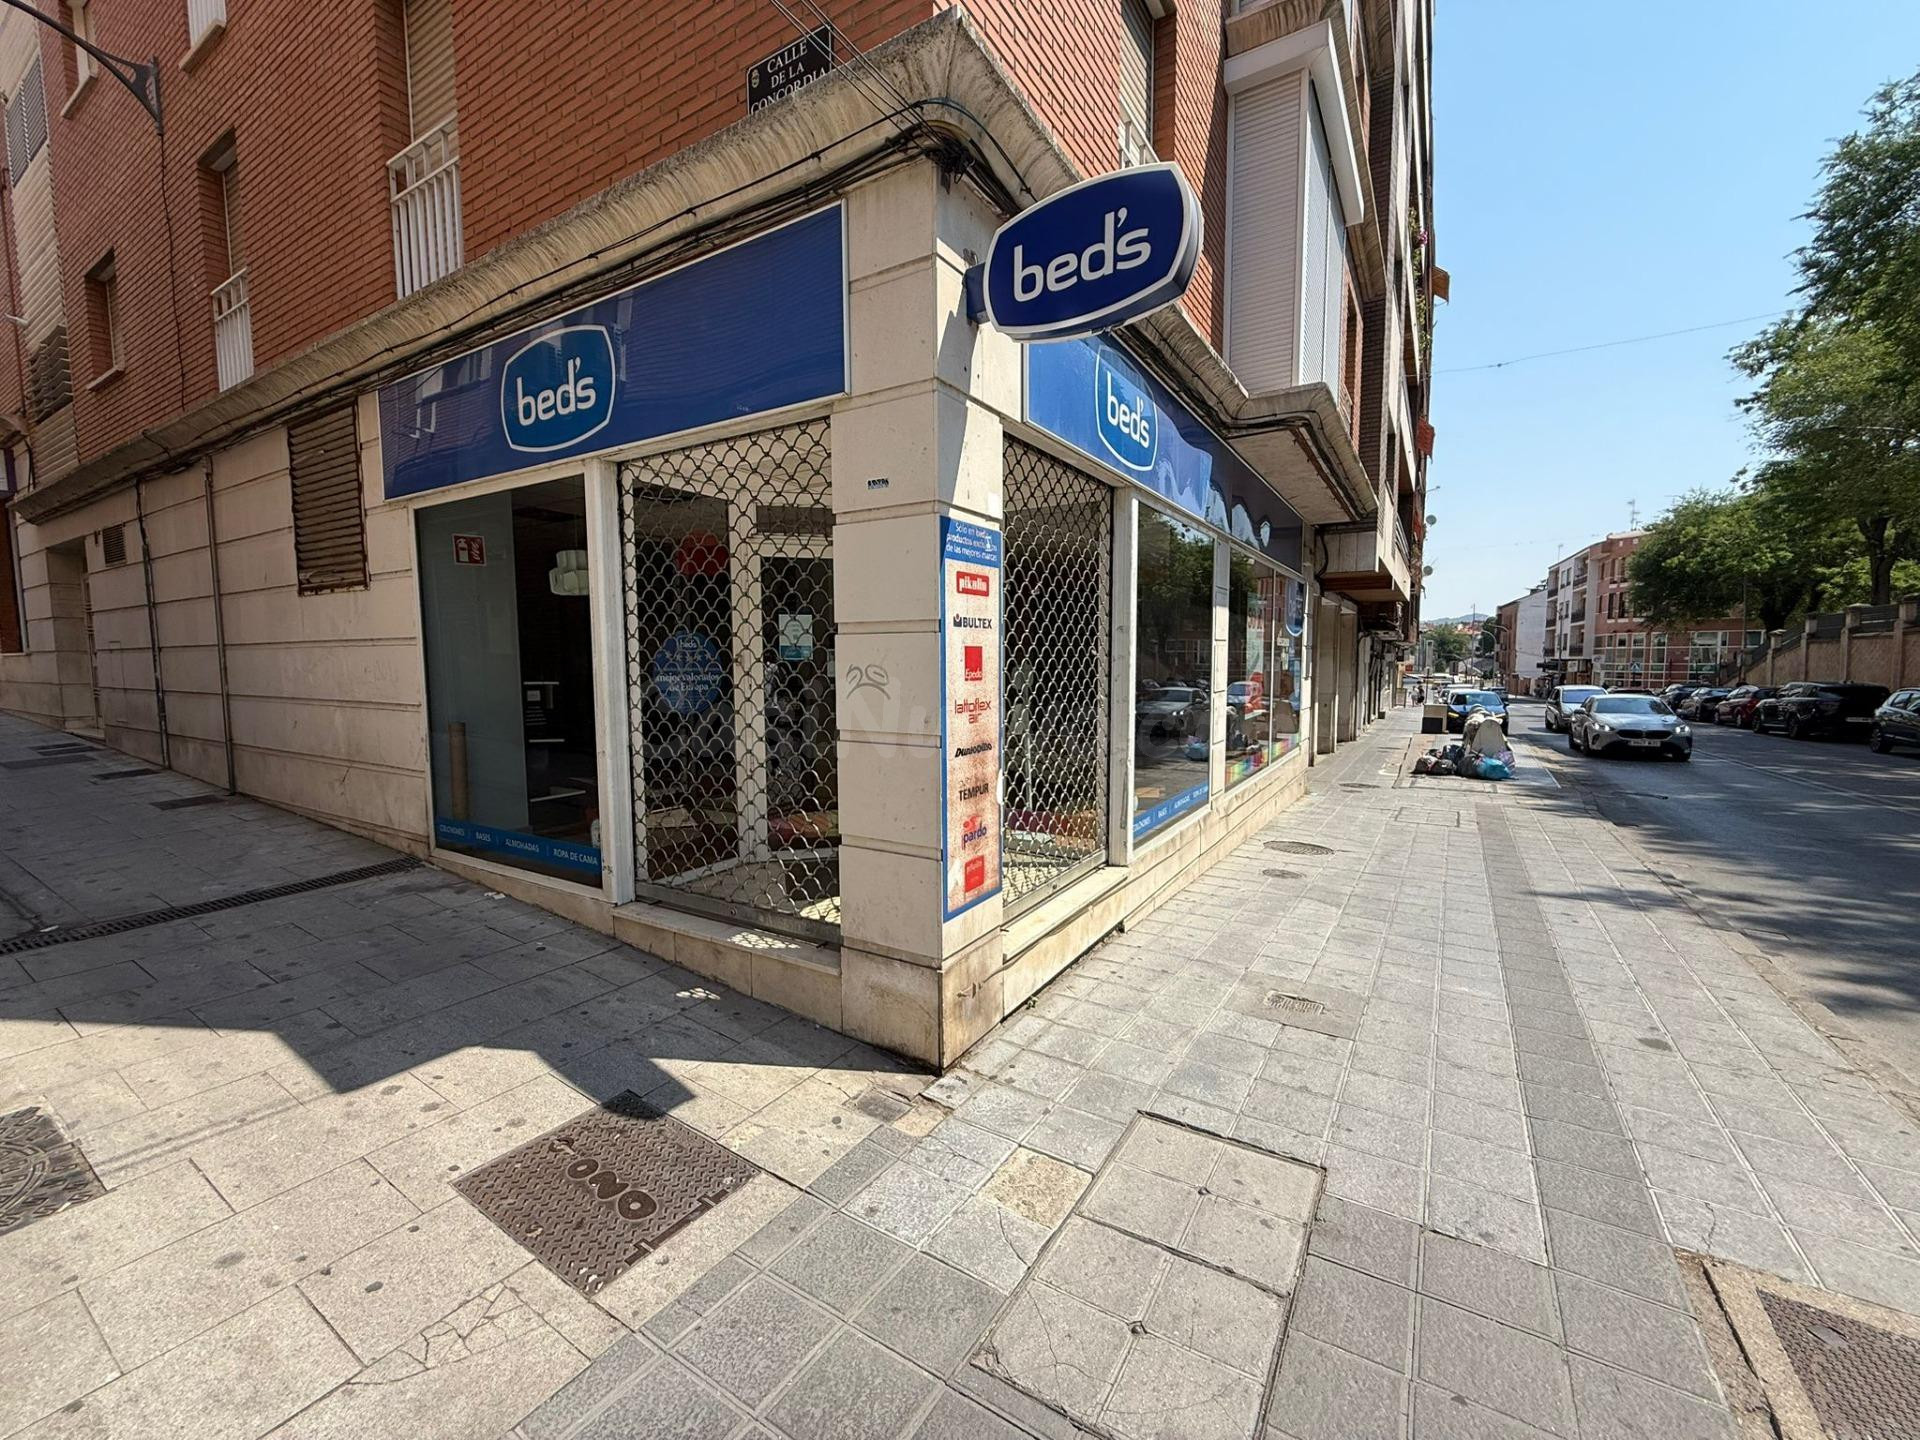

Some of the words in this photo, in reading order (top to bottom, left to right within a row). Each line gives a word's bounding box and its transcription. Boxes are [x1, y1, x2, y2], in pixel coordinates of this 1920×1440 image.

[767, 38, 808, 74] CALLE
[771, 70, 786, 89] DE
[789, 62, 805, 79] LA
[1013, 206, 1152, 303] bed's
[516, 356, 597, 427] bed's
[1106, 370, 1150, 449] bed's
[963, 616, 993, 629] BULTEX
[959, 783, 989, 801] TEMPUR
[579, 854, 598, 866] CAMA
